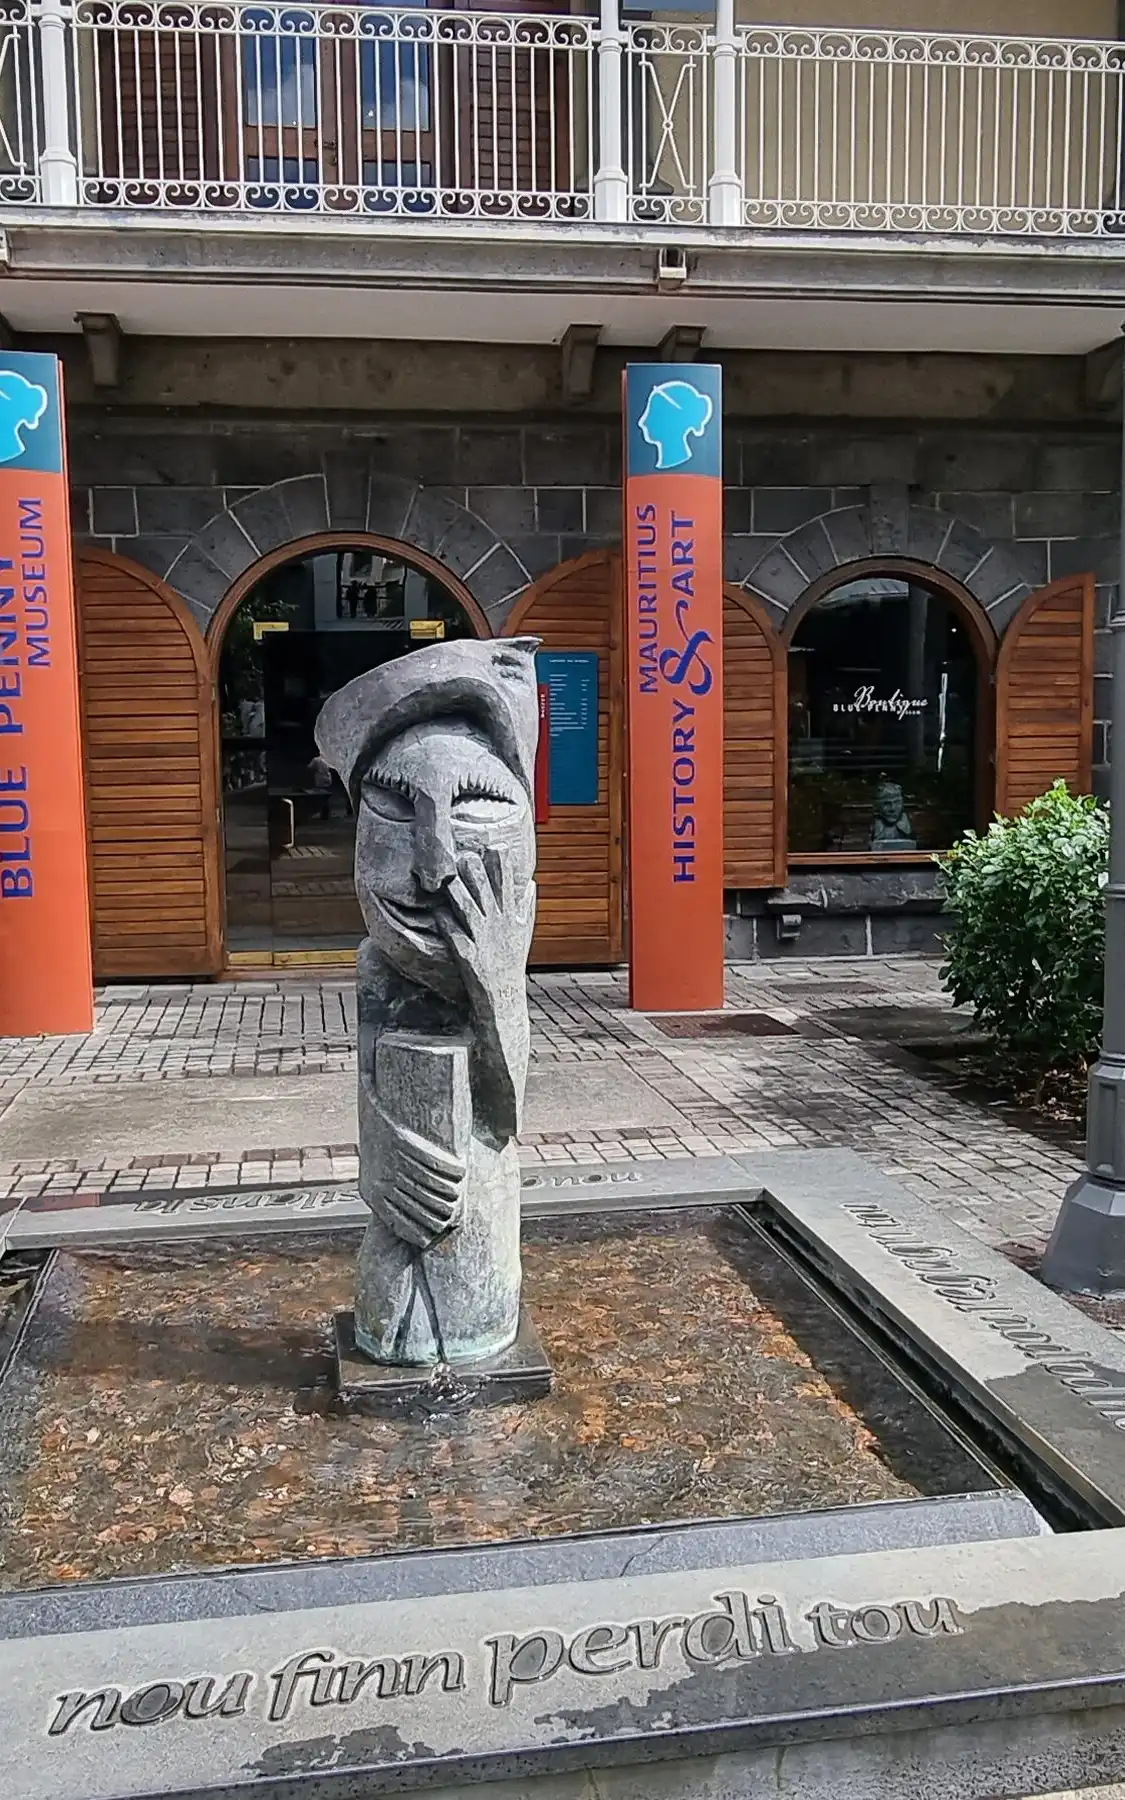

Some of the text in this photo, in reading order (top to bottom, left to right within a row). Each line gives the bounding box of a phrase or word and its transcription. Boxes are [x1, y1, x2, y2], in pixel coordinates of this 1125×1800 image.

[18, 497, 51, 667] MUSEUM
[636, 502, 659, 694] MAURITIUS
[660, 509, 715, 884] HISTORY & ART
[853, 685, 928, 721] Boutique
[0, 766, 34, 899] BLUE
[552, 1170, 641, 1189] nou
[48, 1590, 966, 1737] nou finn perdi tou
